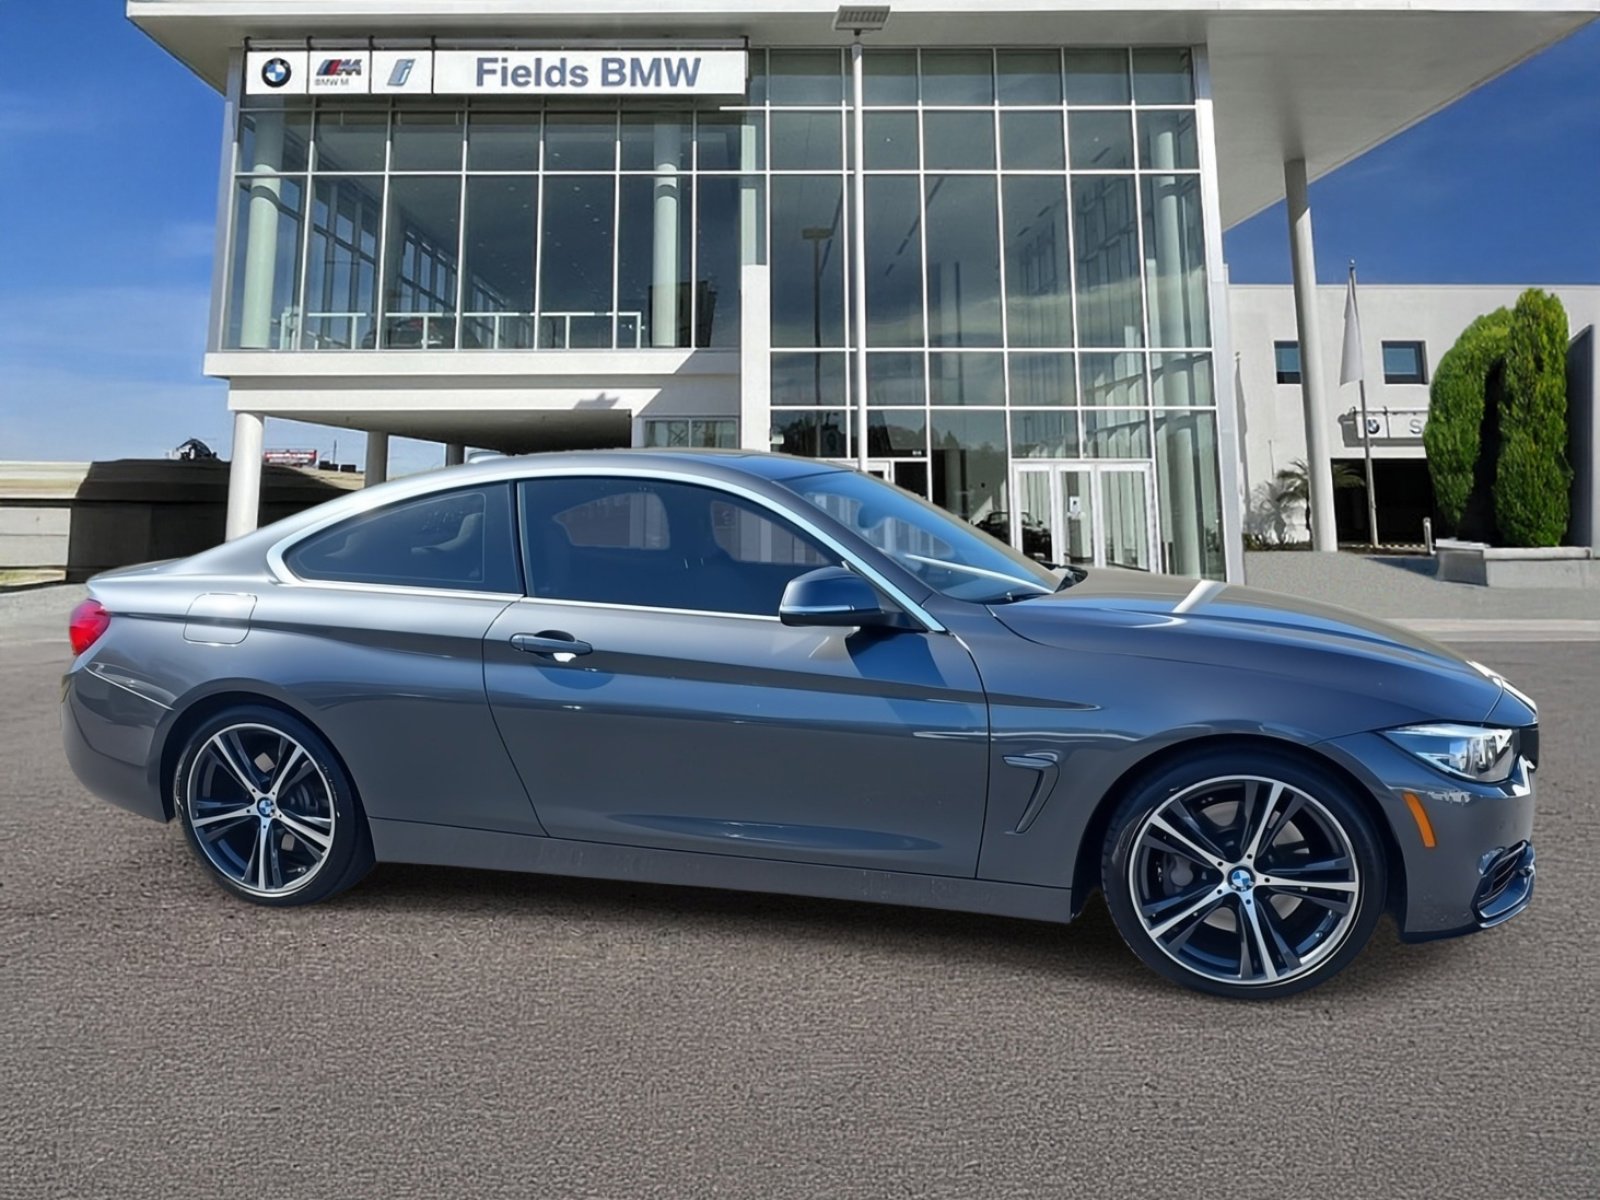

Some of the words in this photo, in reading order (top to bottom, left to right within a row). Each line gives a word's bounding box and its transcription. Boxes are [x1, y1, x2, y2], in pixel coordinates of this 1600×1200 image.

[476, 57, 589, 87] Fields
[600, 57, 702, 87] BMW
[315, 78, 338, 86] BMW
